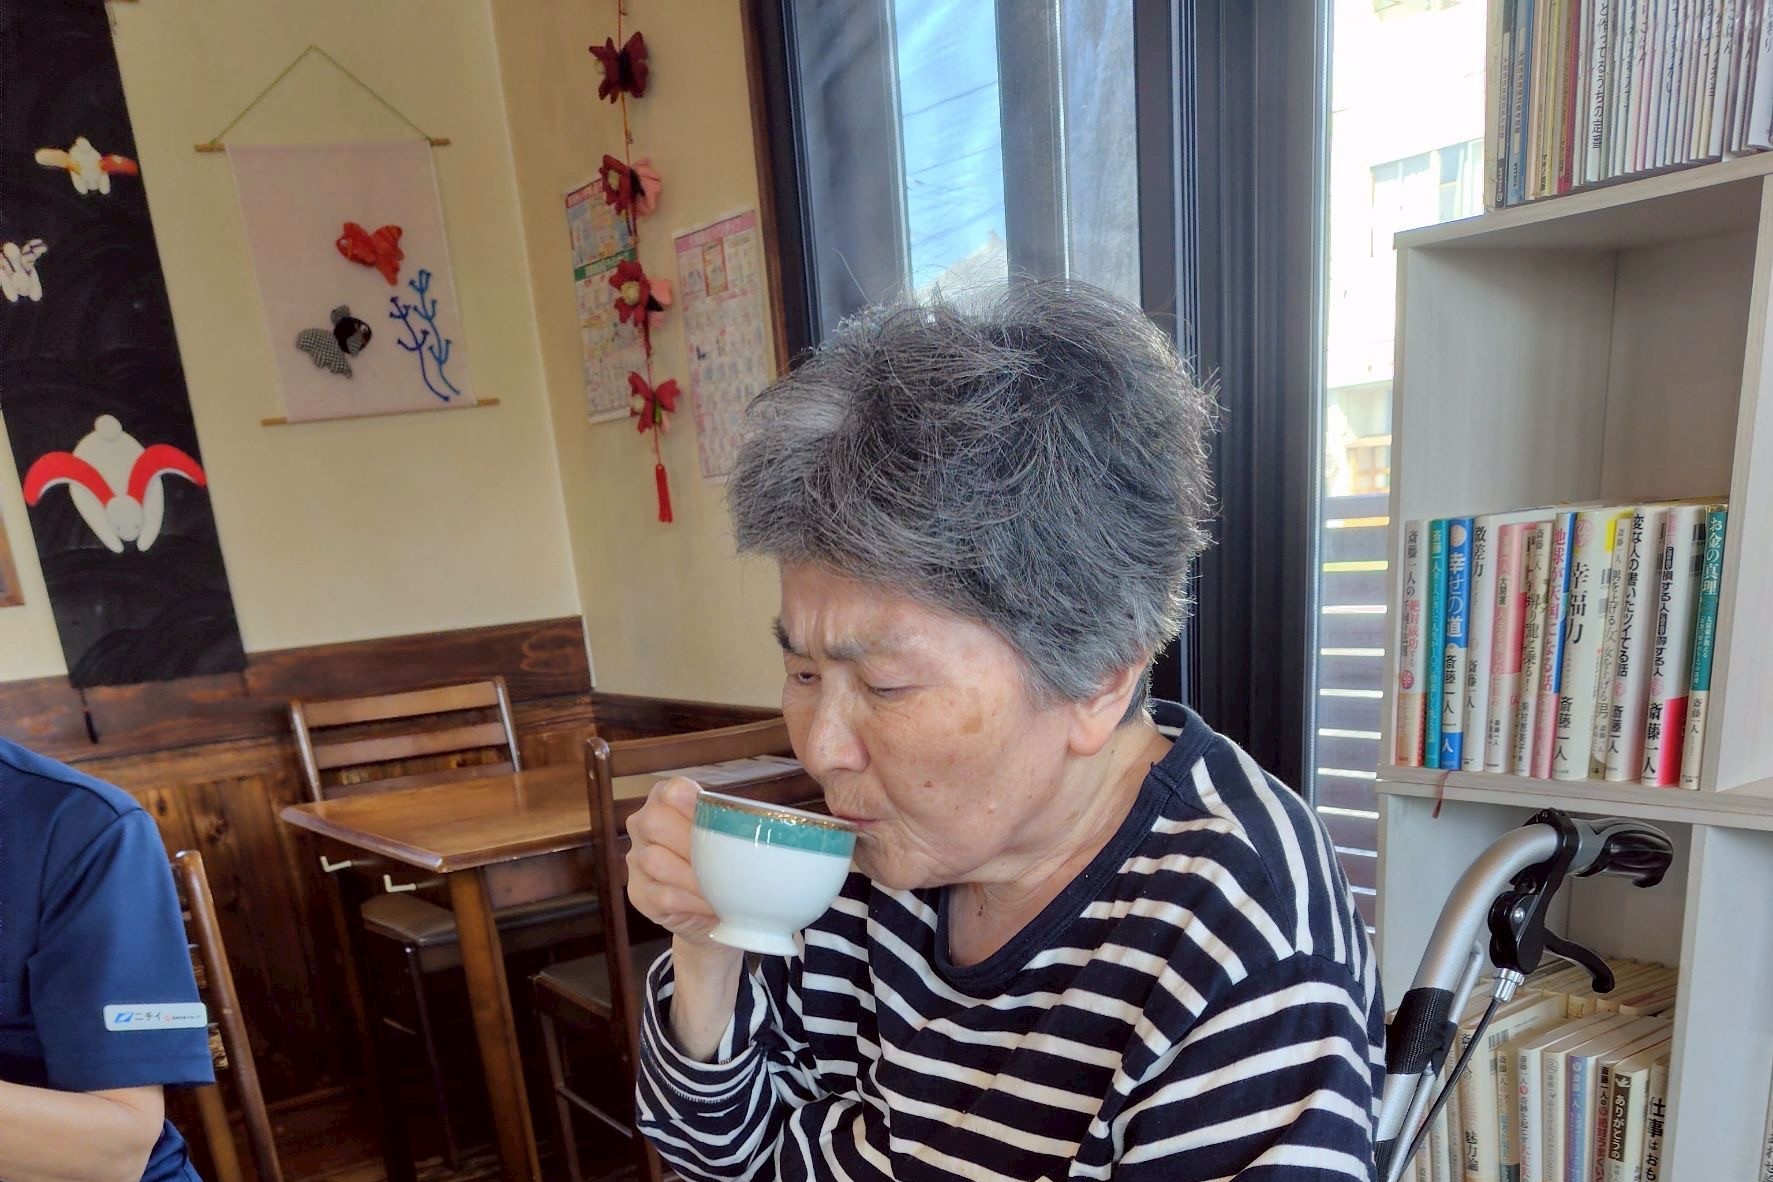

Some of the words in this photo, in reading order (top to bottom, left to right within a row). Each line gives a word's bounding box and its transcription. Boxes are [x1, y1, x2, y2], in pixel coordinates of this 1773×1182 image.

[1447, 552, 1467, 638] 幸せの道
[1703, 517, 1723, 595] お金の真理
[1567, 562, 1591, 644] 幸福力
[1611, 1093, 1627, 1159] ありがとうの
